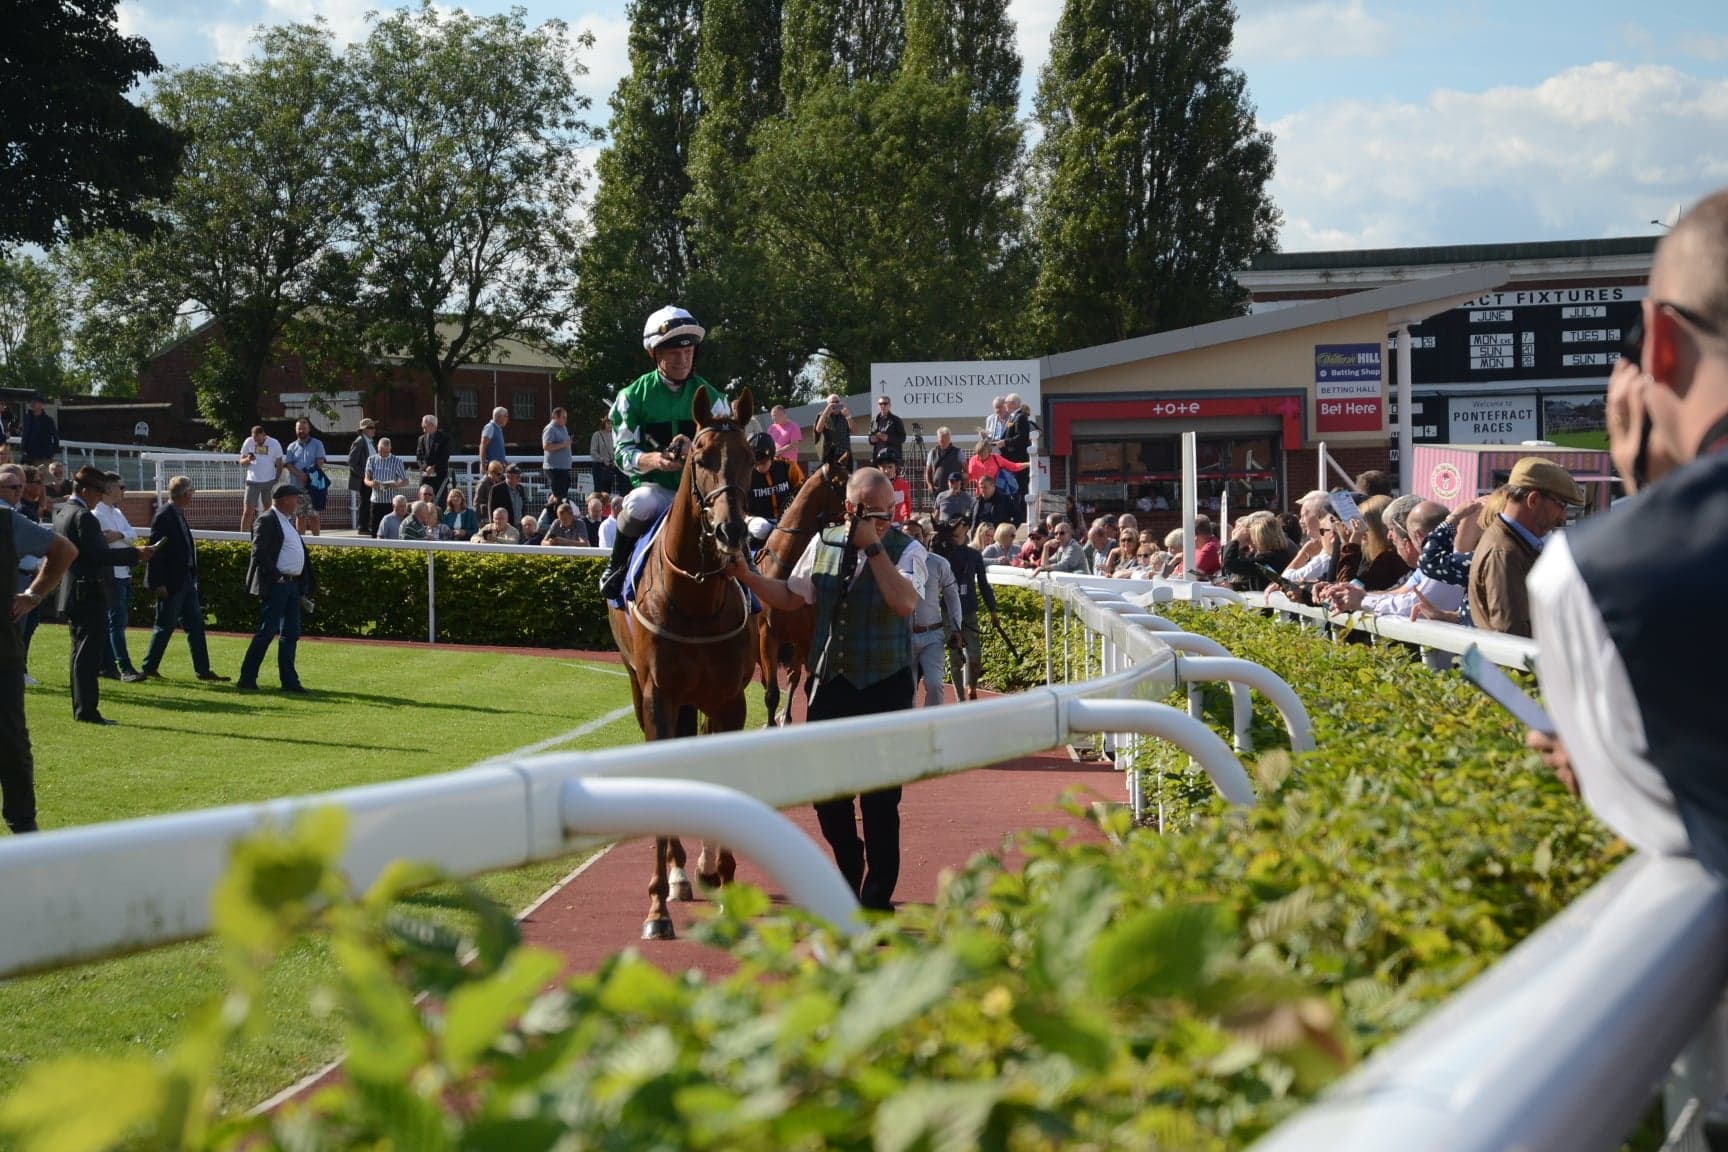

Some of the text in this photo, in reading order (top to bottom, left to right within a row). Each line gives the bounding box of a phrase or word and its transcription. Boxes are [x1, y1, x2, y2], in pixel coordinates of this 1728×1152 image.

[1517, 288, 1623, 304] FIXTURES
[1478, 310, 1506, 321] JUNE
[1570, 306, 1598, 318] JULY
[1473, 335, 1498, 345] MON
[1570, 330, 1599, 342] TUES
[1479, 346, 1502, 357] SUN
[1357, 353, 1380, 364] HILL
[1480, 358, 1504, 368] MON
[1572, 354, 1596, 365] SUN
[1331, 368, 1381, 377] Betting Shop
[904, 373, 1031, 388] ADMINISTRATION
[1321, 385, 1377, 394] BETTING HALL
[904, 391, 964, 405] OFFICES
[1321, 403, 1342, 415] Bet
[1346, 402, 1377, 414] Here
[1453, 409, 1533, 422] PONTEFRACT
[1473, 422, 1513, 433] RACES
